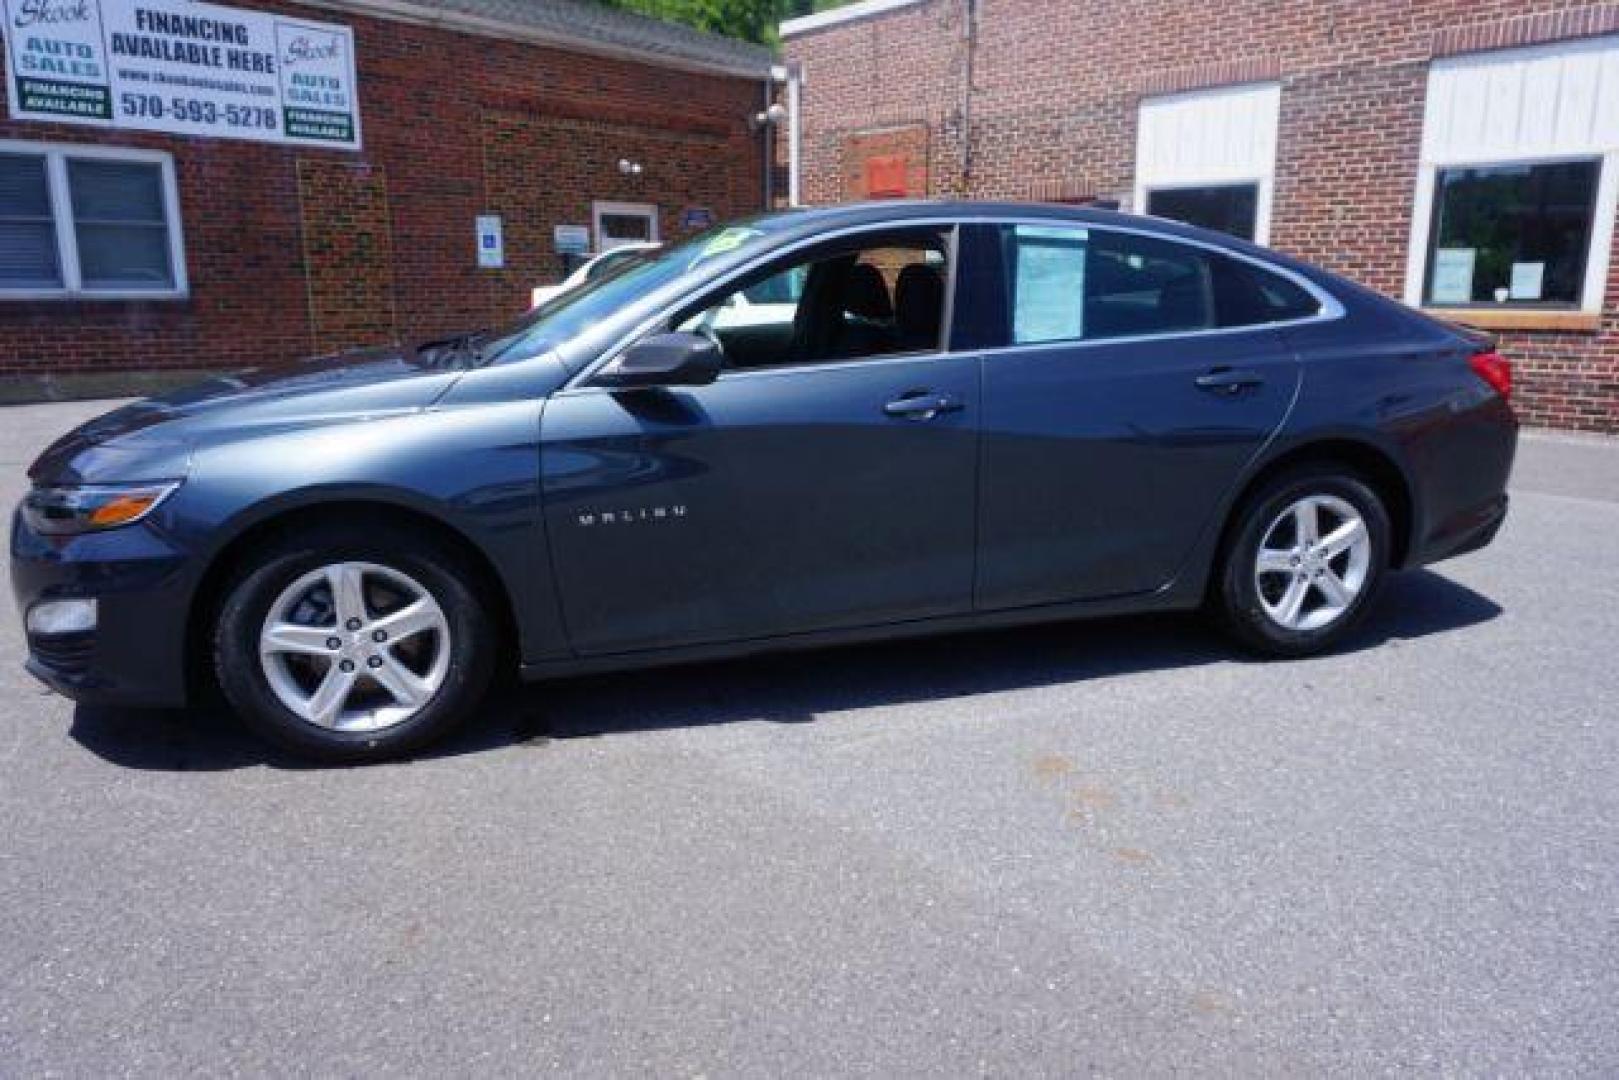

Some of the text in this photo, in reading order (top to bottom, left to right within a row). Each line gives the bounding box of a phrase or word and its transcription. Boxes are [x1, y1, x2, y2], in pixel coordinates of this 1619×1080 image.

[136, 8, 249, 46] FINANCING
[27, 37, 93, 59] AUTO
[111, 33, 275, 74] AVAILABLE HERE
[22, 54, 101, 77] SALES
[291, 73, 340, 89] AUTO
[121, 93, 277, 129] 570-593-5278
